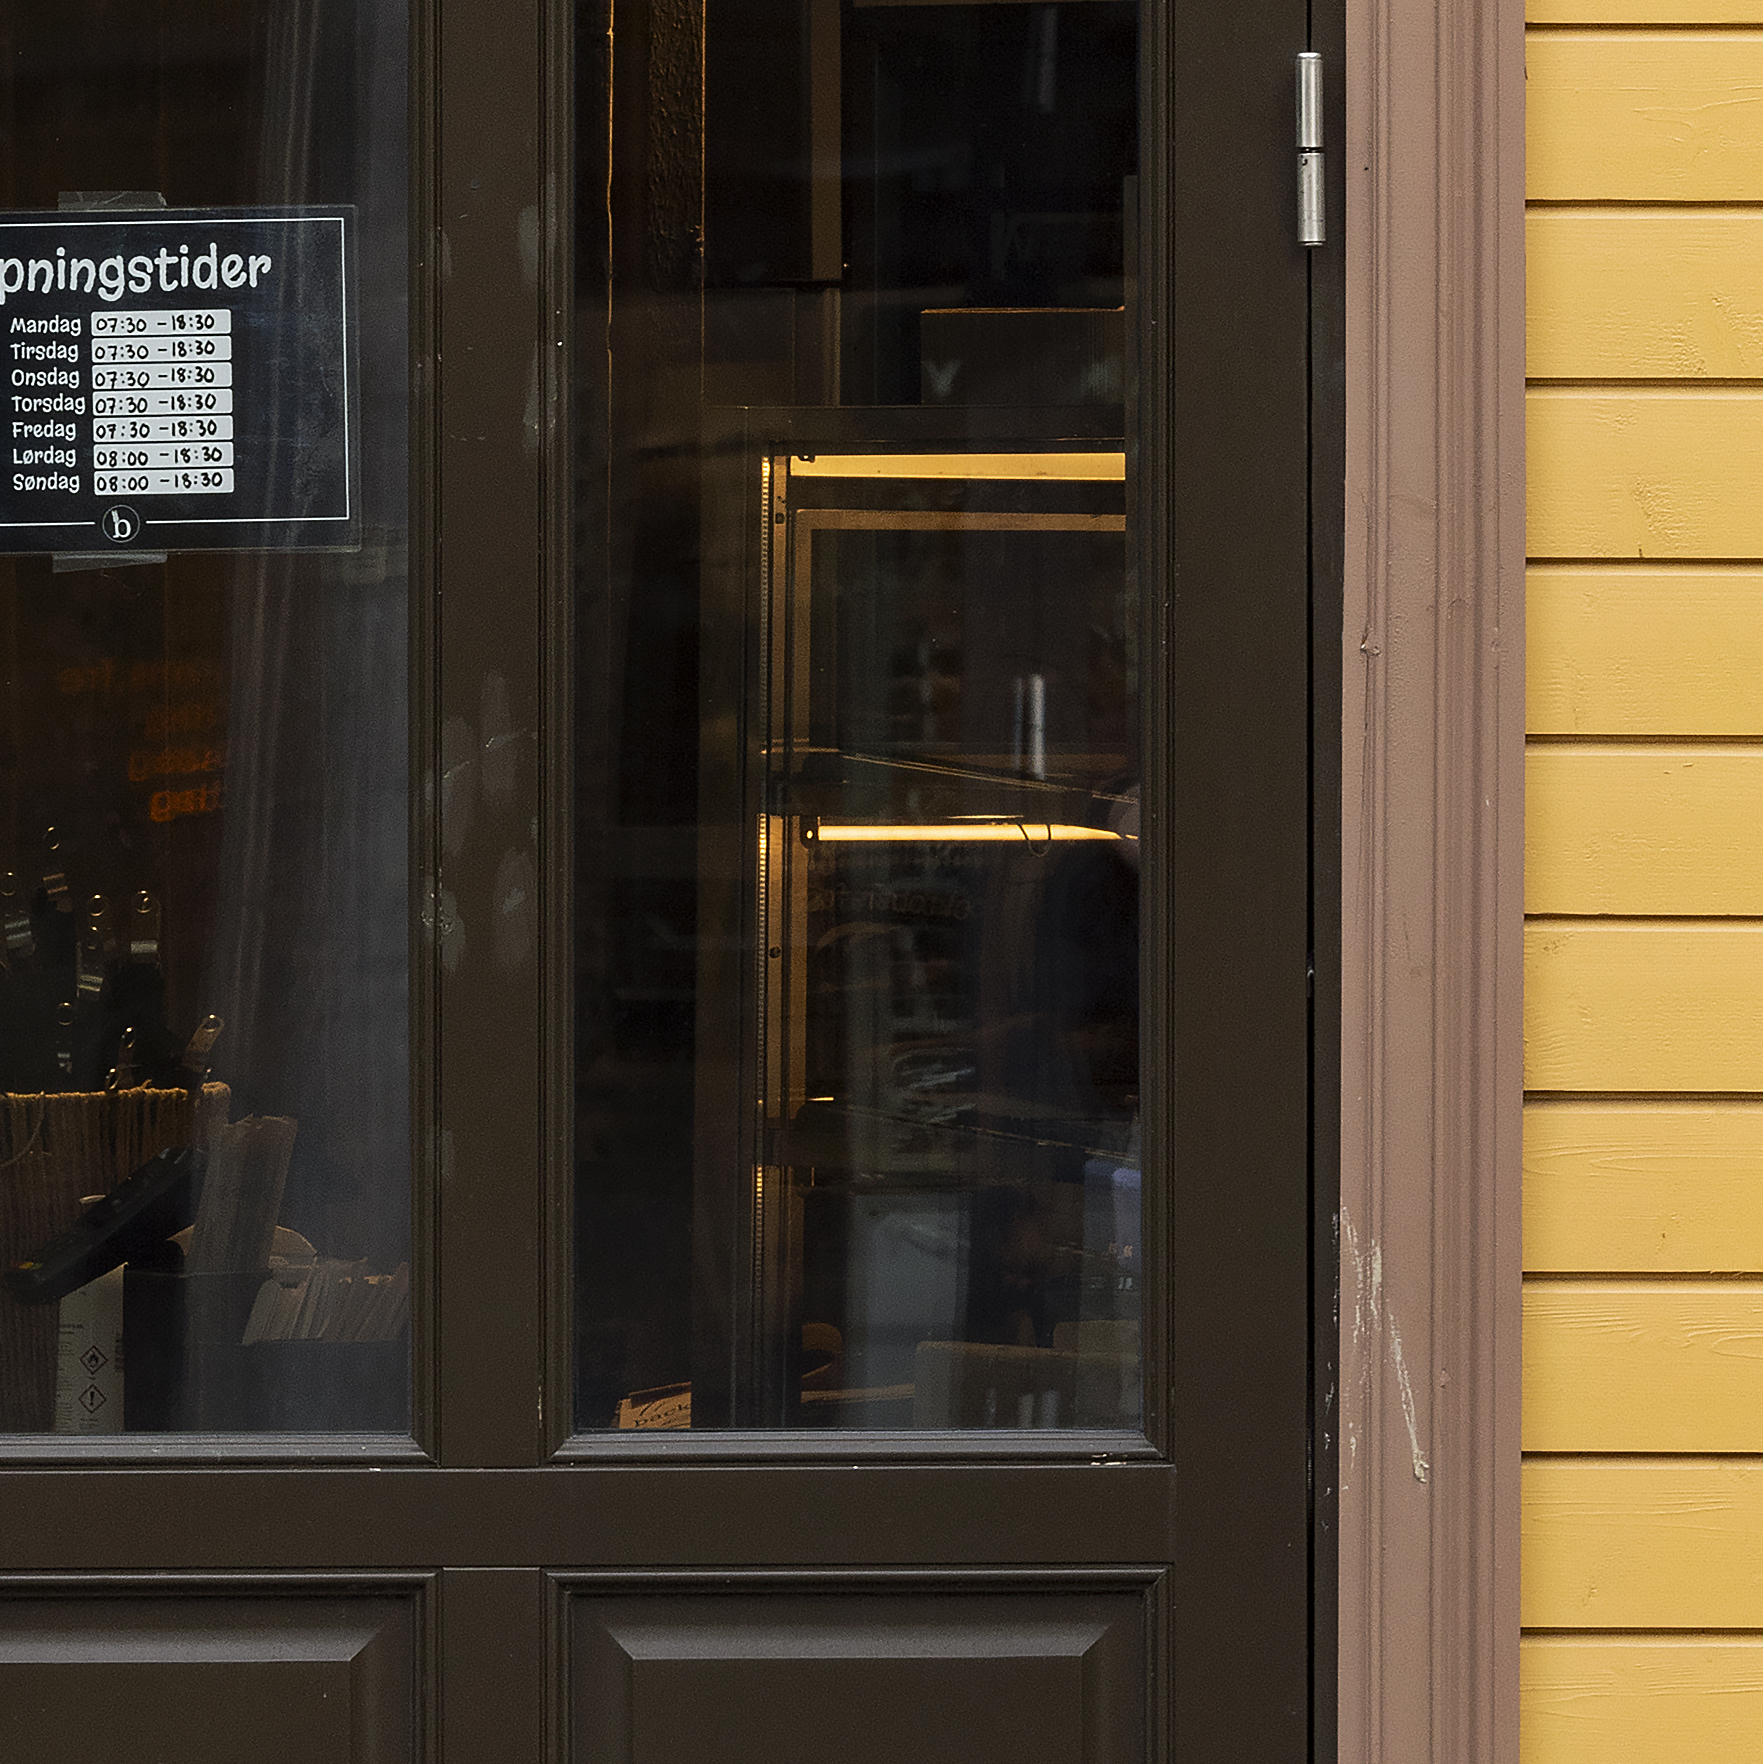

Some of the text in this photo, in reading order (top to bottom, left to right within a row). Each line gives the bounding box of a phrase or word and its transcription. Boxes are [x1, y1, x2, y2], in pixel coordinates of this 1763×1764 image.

[10, 315, 81, 336] Mandag
[97, 318, 146, 333] 07:30
[10, 341, 78, 362] Tirsdag
[95, 345, 148, 360] 07:30
[12, 367, 79, 388] Onsdag
[95, 371, 149, 388] 07:30
[11, 393, 85, 414] Torsdag
[96, 397, 147, 414] 07:30
[12, 419, 76, 441] Fredag
[96, 422, 150, 439] 07:30
[13, 445, 76, 467] Lørdag
[97, 451, 148, 467] 08:00
[13, 472, 79, 493] Søndag
[97, 476, 148, 492] 08:00
